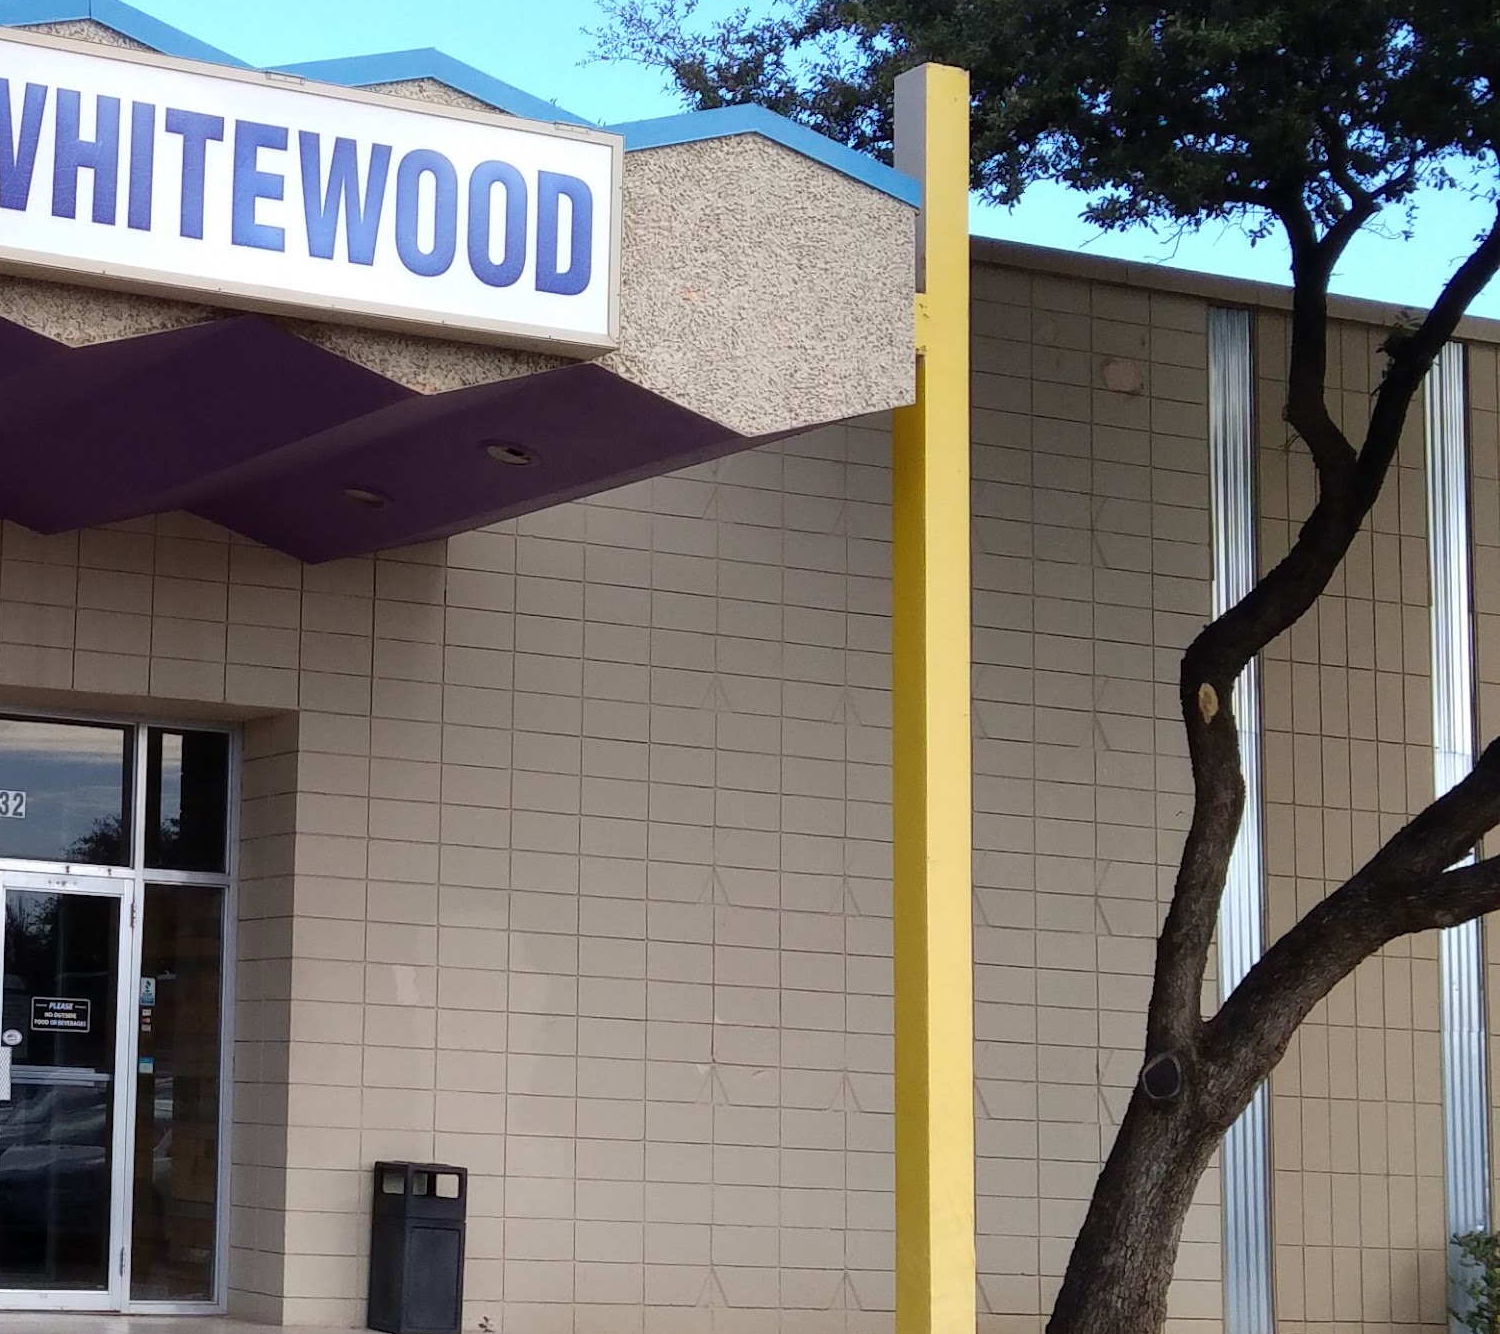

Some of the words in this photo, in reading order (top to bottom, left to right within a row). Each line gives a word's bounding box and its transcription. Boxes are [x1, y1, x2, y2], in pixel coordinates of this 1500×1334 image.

[48, 1001, 74, 1010] PLEASE
[33, 1018, 49, 1026] FOOD
[57, 1019, 87, 1027] BEVERAGES
